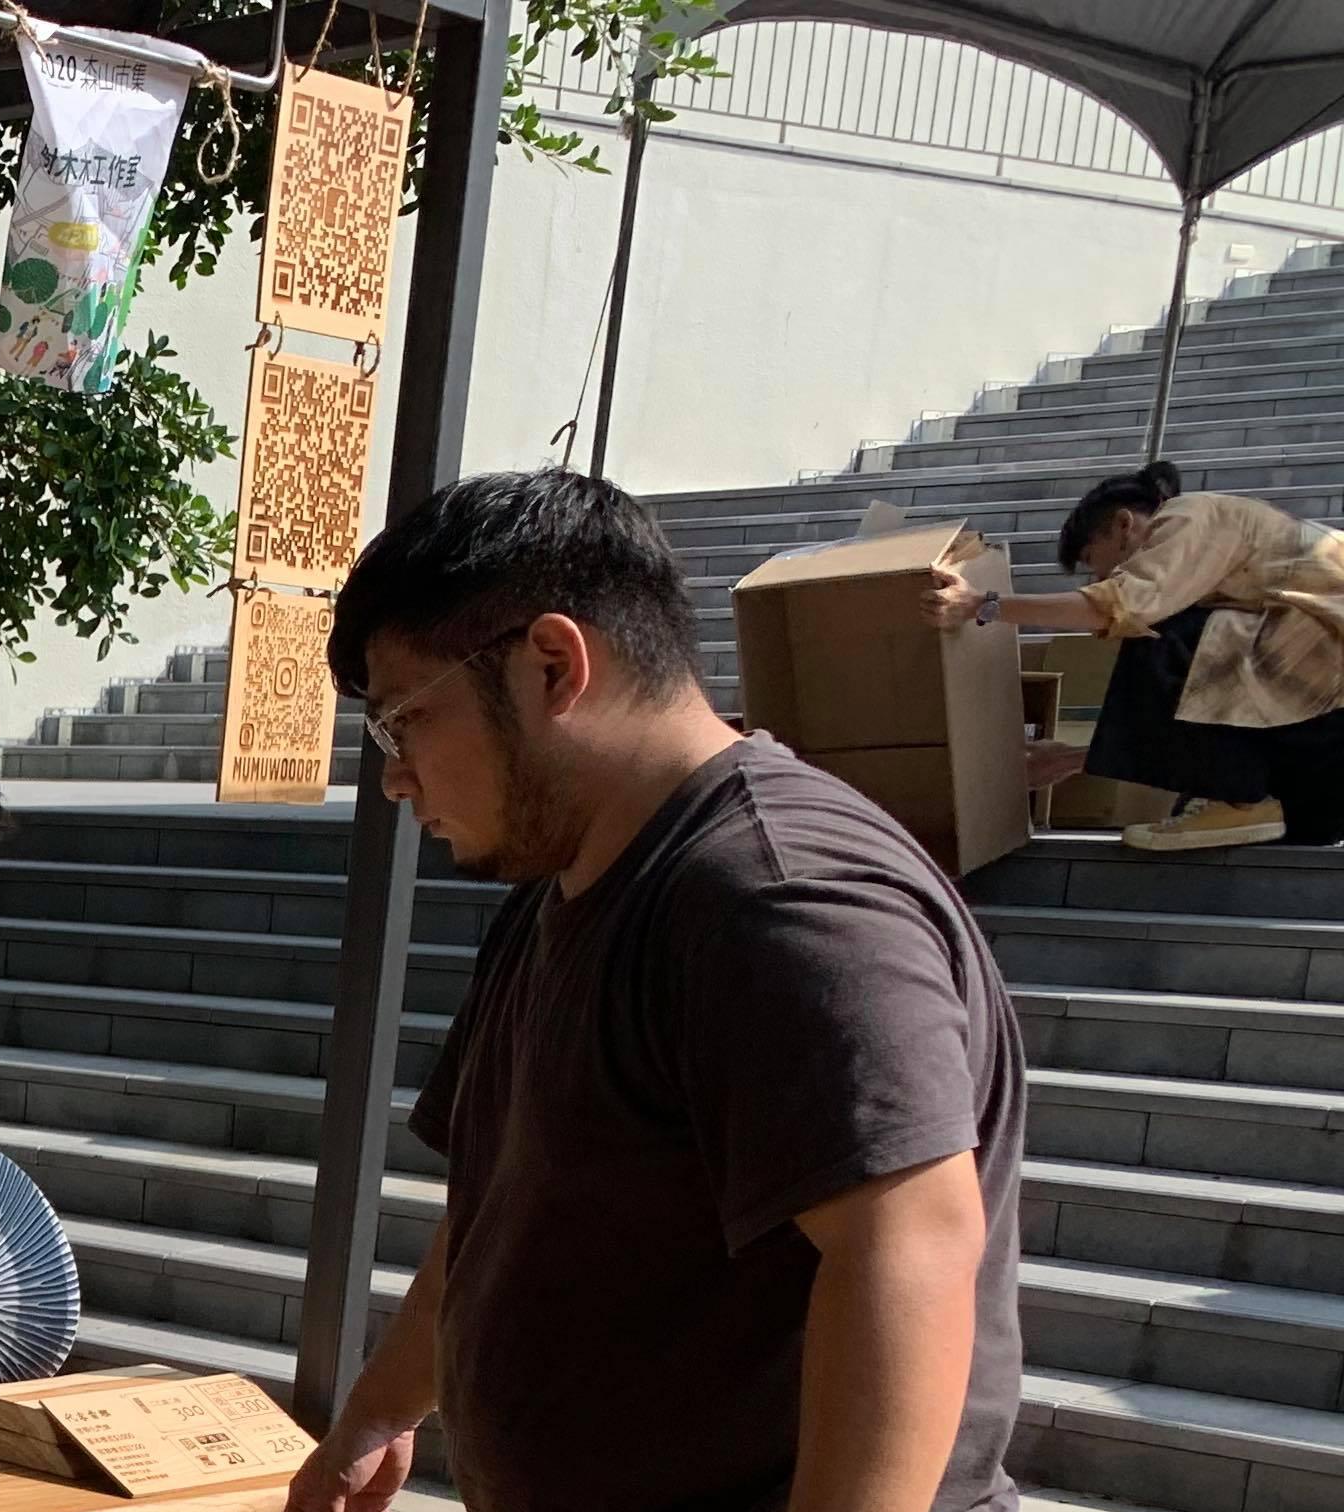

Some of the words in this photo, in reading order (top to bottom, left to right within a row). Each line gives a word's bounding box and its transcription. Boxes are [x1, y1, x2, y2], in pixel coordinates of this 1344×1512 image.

[80, 54, 147, 93] 森山市集
[232, 755, 321, 783] MUMUWOOD87
[267, 1435, 307, 1454] 285
